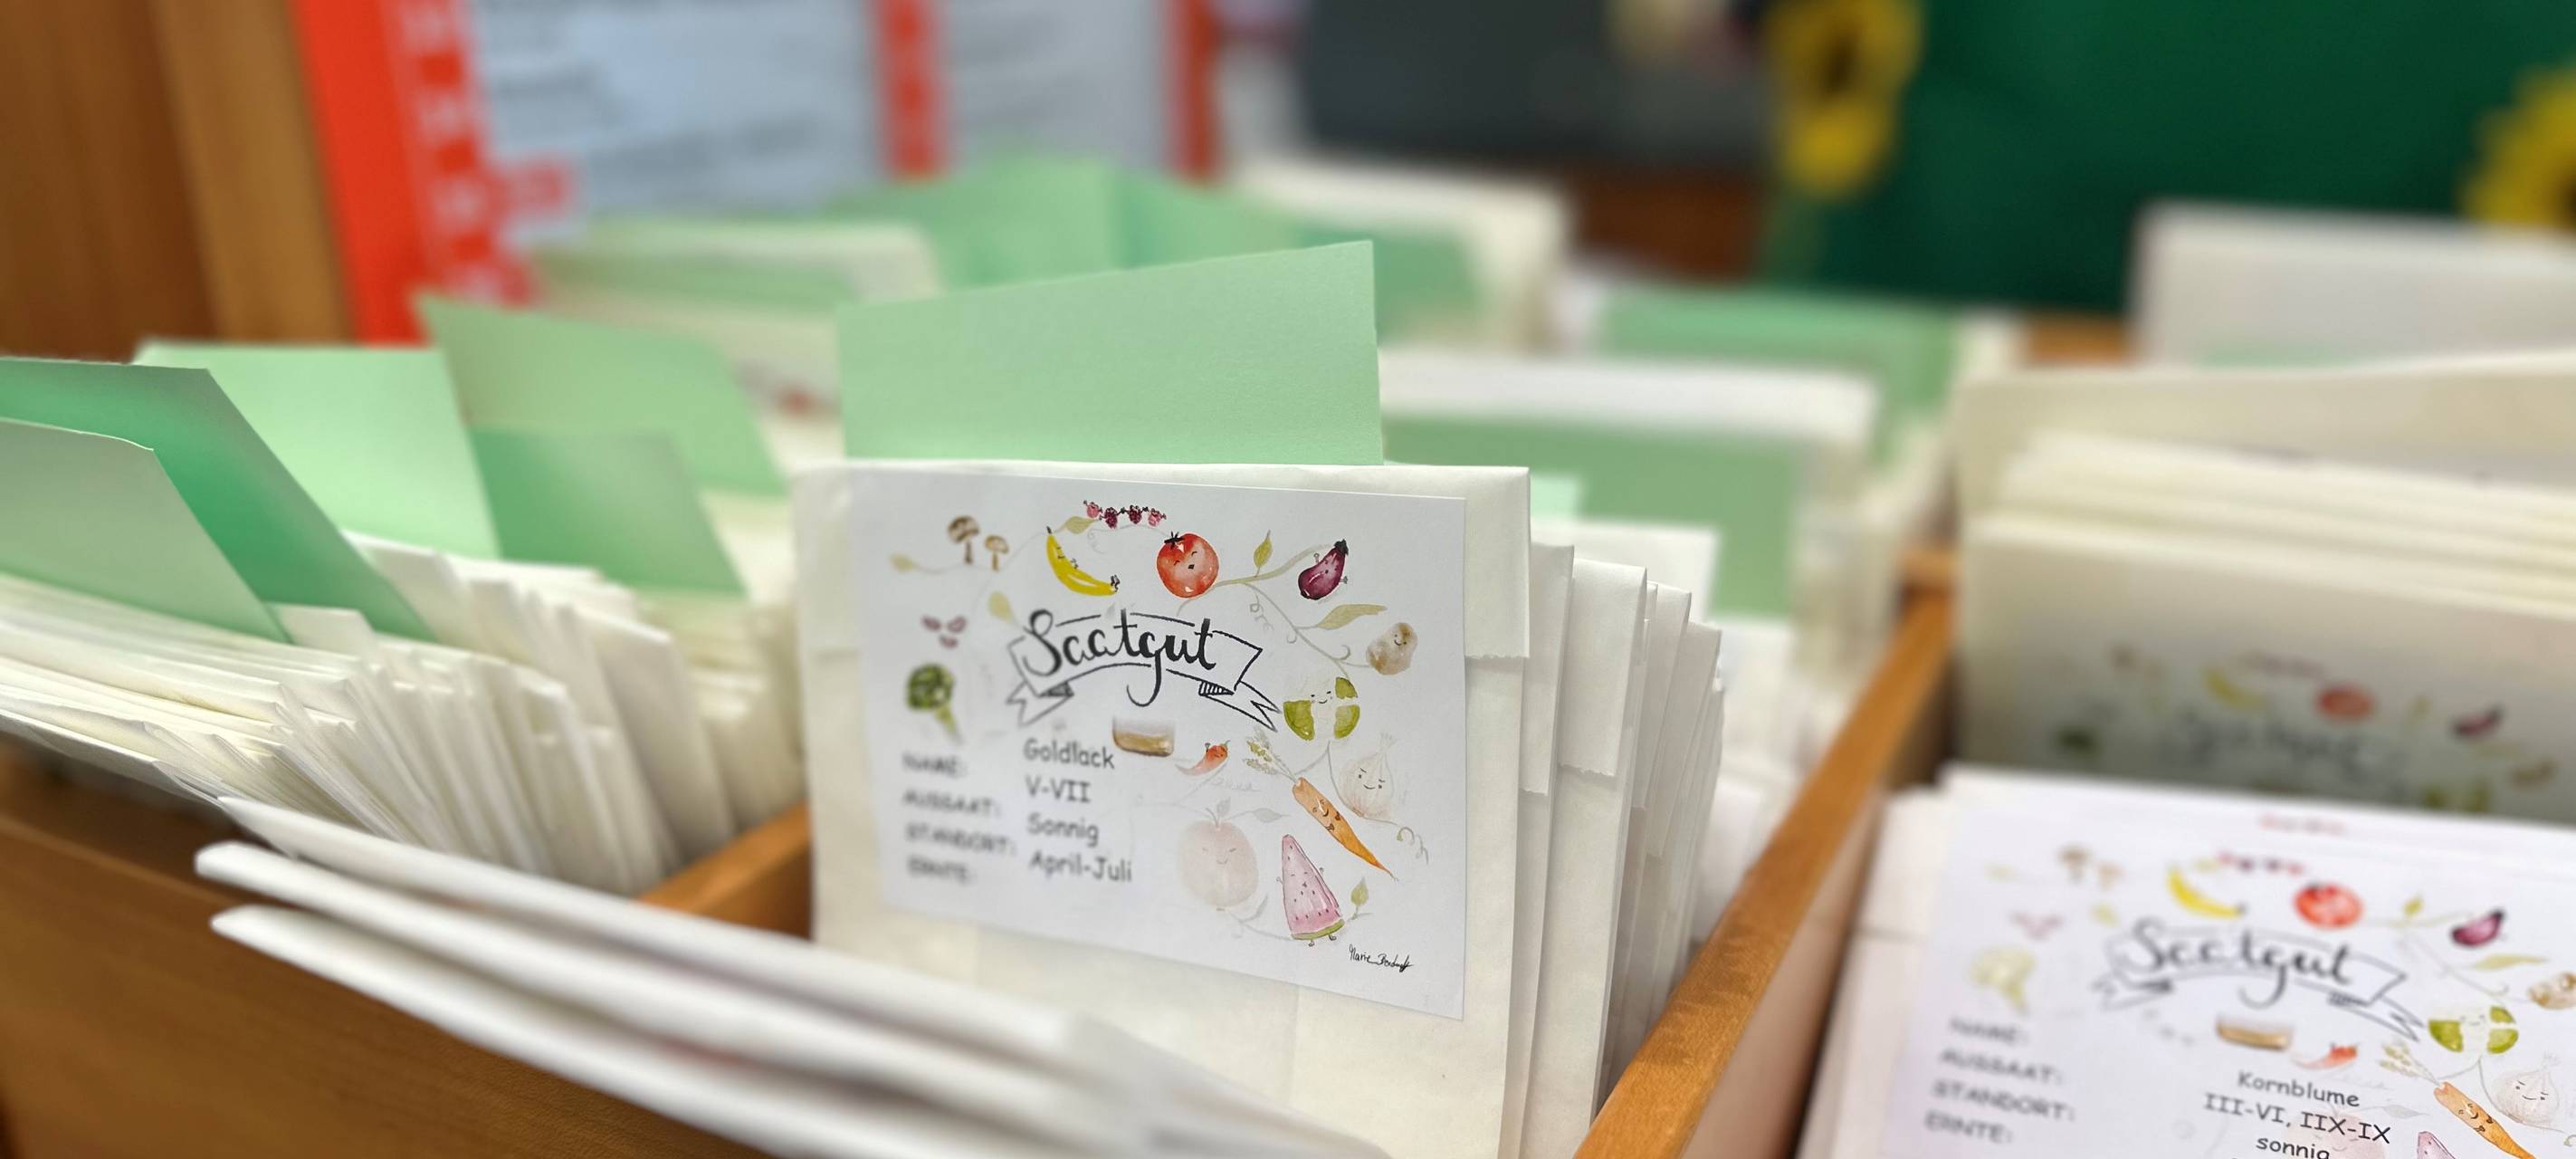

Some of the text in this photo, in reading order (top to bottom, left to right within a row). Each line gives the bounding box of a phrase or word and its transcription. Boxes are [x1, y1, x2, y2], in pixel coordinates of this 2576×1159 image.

[1021, 608, 1216, 707] Saatgut
[1023, 738, 1115, 769] Goldlack
[1025, 775, 1092, 802] V-VII
[1026, 813, 1100, 848] Sonnig
[1029, 849, 1132, 882] April-Juli
[2124, 915, 2352, 1010] Saatgut
[2237, 1070, 2361, 1107] Kornblume
[2203, 1092, 2391, 1145] III-VI, IIX-IX
